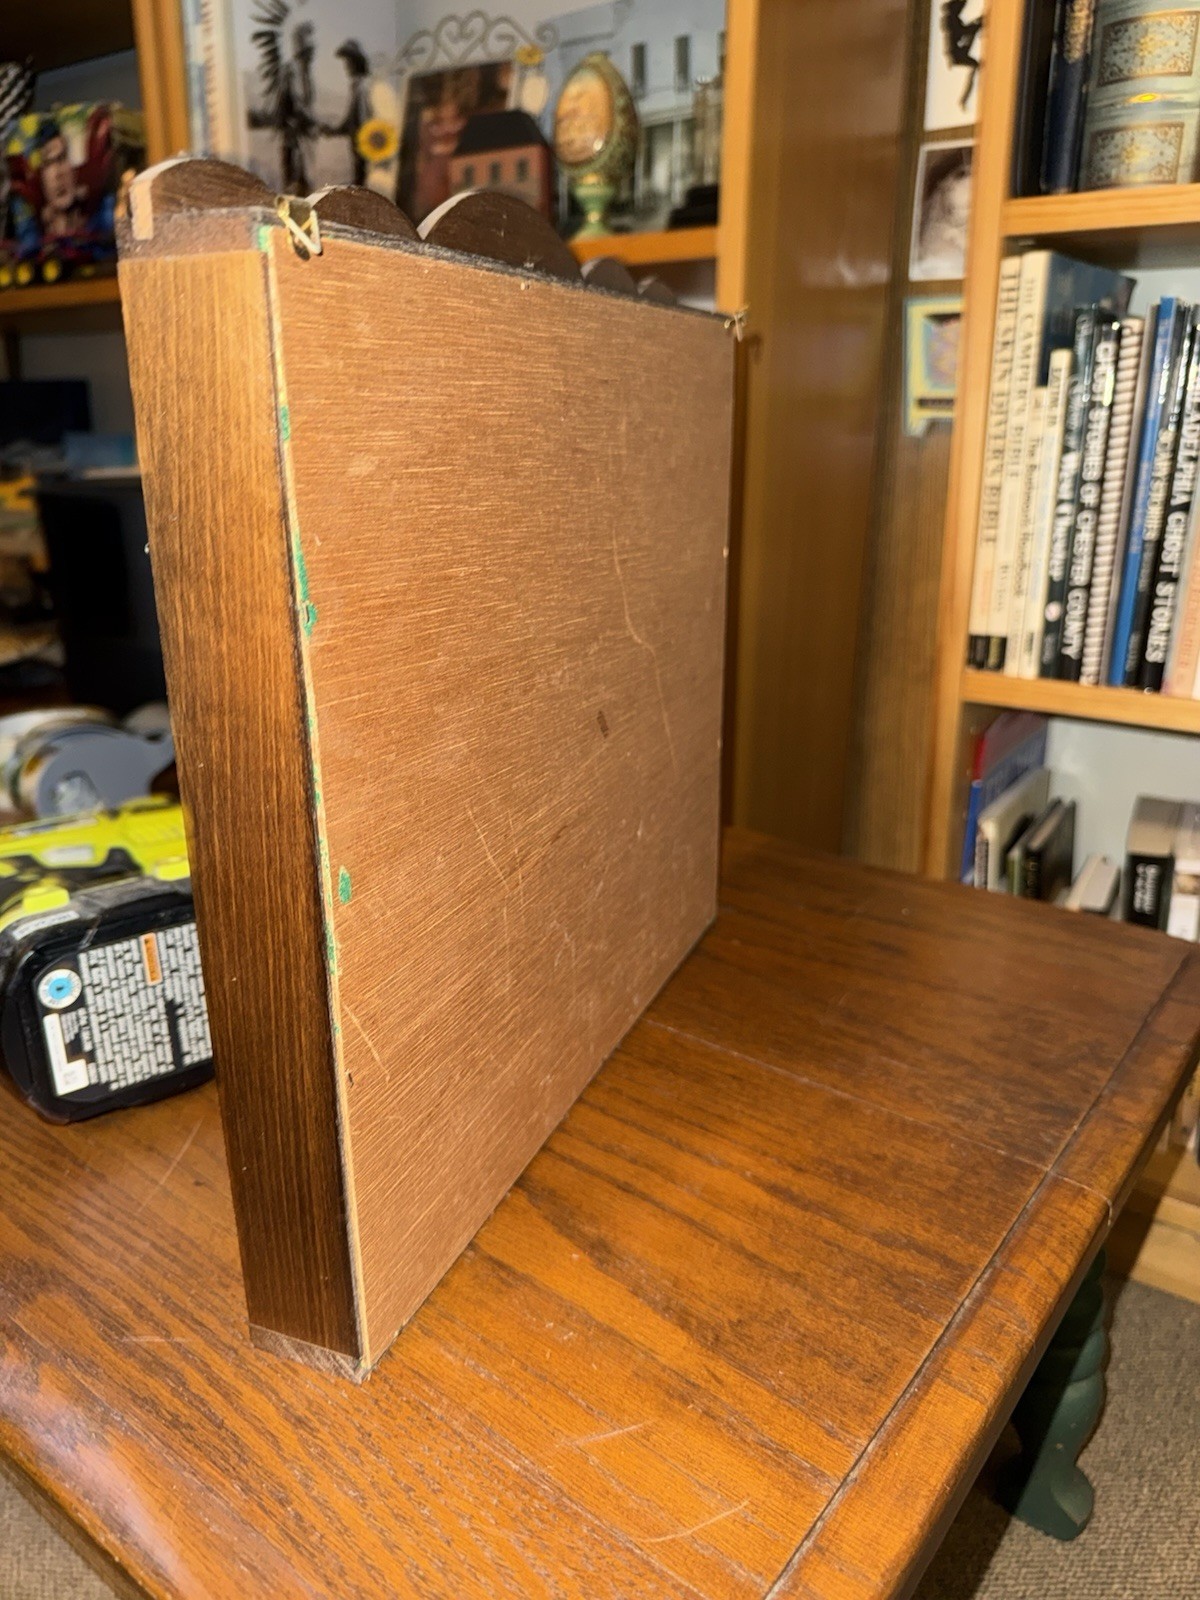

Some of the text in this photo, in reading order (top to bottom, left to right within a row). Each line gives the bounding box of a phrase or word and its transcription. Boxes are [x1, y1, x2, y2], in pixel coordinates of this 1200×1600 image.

[1000, 271, 1020, 318] THE
[993, 325, 1015, 382] SKIN
[1059, 450, 1083, 500] West
[1082, 406, 1110, 480] STORIES
[979, 485, 1001, 547] BIBLE
[1079, 481, 1101, 508] OF
[1143, 478, 1169, 541] STORIES
[1049, 501, 1075, 582] Chester
[1069, 509, 1098, 587] CHESTER
[1159, 510, 1187, 578] GHOST
[1061, 587, 1089, 660] COUNTY
[1145, 579, 1177, 663] STORIES
